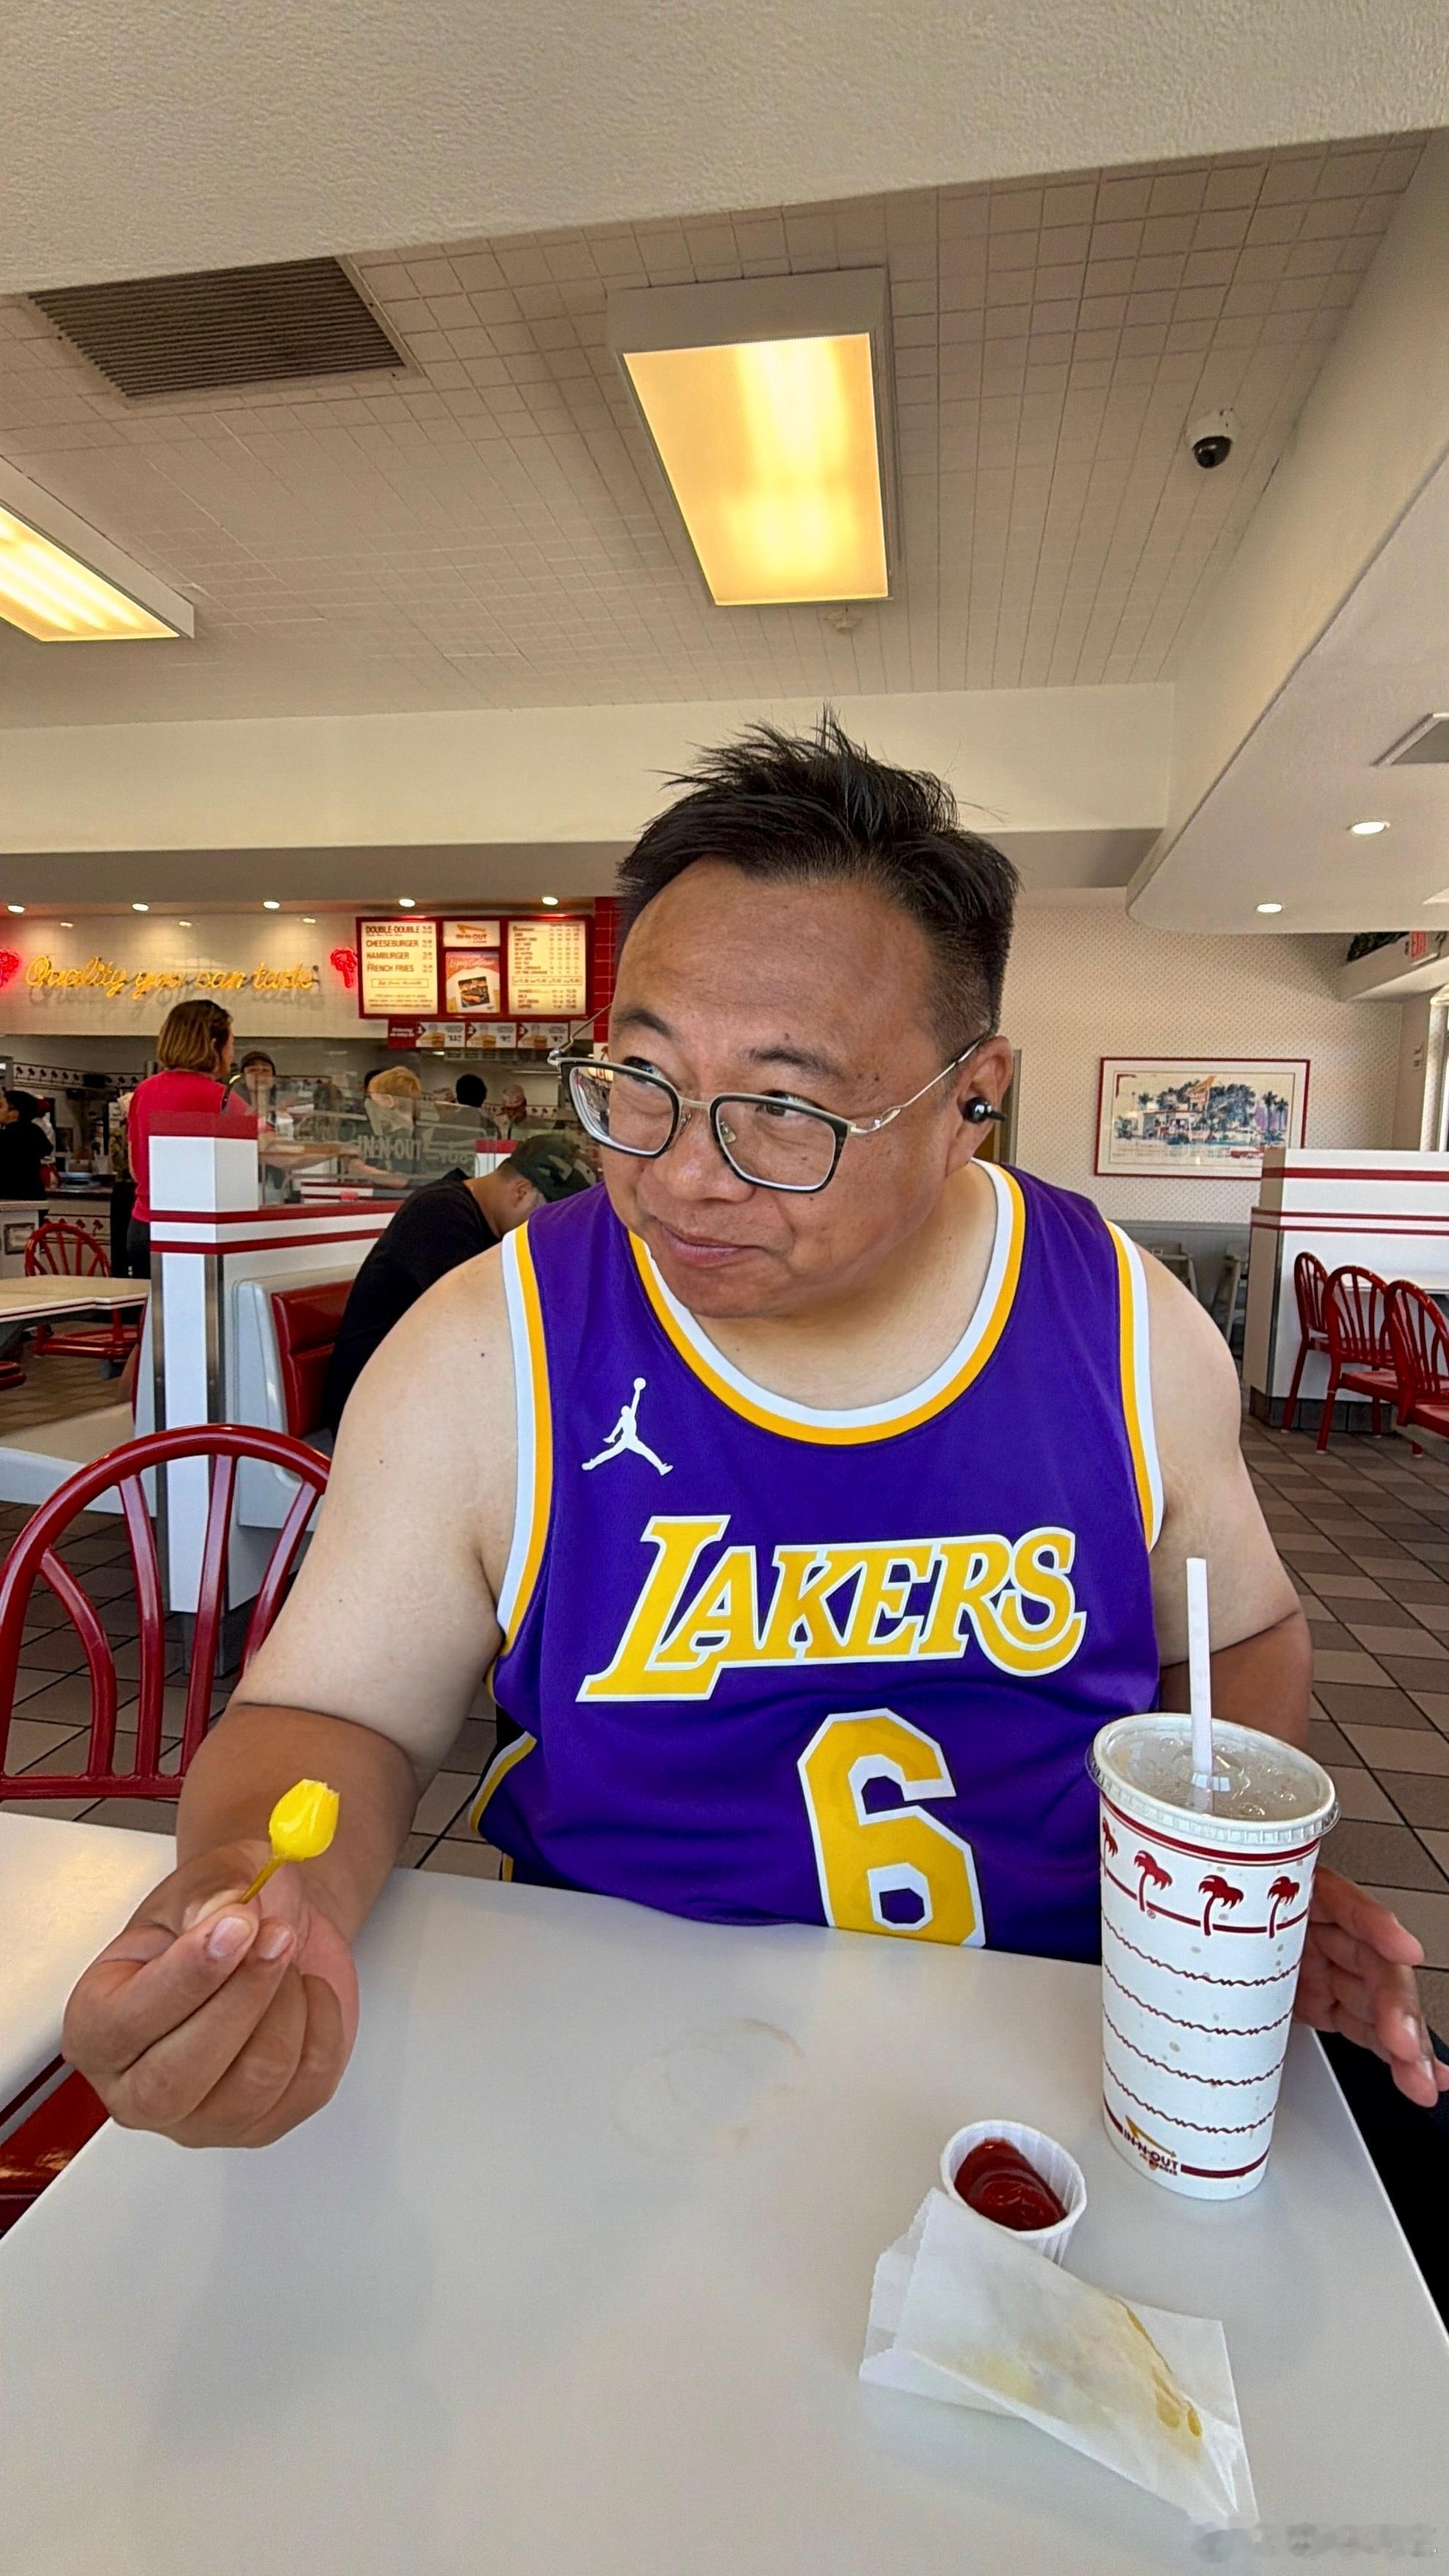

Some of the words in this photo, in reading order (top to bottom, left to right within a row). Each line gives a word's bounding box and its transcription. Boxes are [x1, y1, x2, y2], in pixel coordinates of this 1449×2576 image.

[26, 955, 127, 998] Quality
[132, 971, 182, 1000] you
[197, 970, 246, 989] can
[253, 960, 312, 989] taste
[576, 1515, 1087, 1702] LAKERS
[797, 1707, 986, 1949] 6
